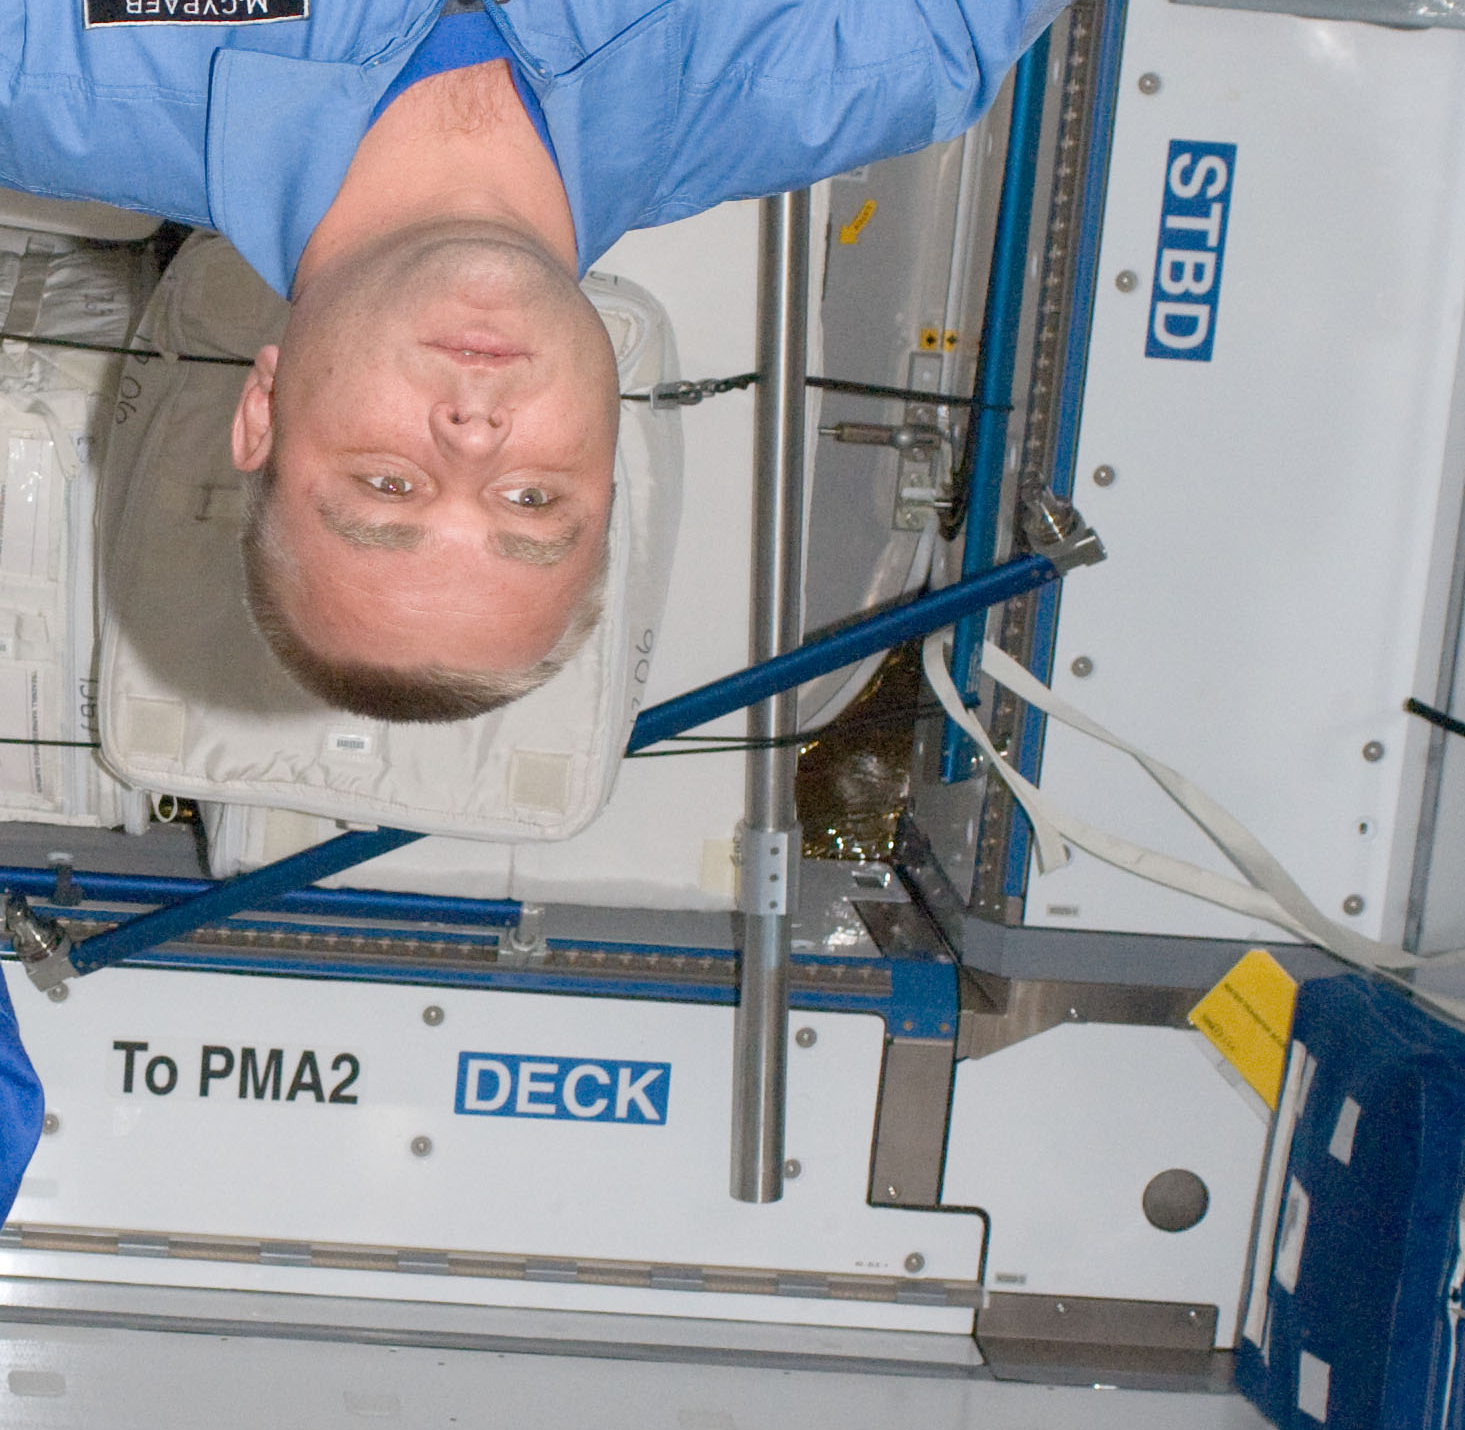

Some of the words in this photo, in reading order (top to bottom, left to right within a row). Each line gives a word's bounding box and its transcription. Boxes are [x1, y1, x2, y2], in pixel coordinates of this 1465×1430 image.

[1153, 151, 1228, 351] STBD
[113, 1041, 178, 1096] To
[199, 1045, 361, 1105] PMA2
[463, 1059, 663, 1121] DECK
